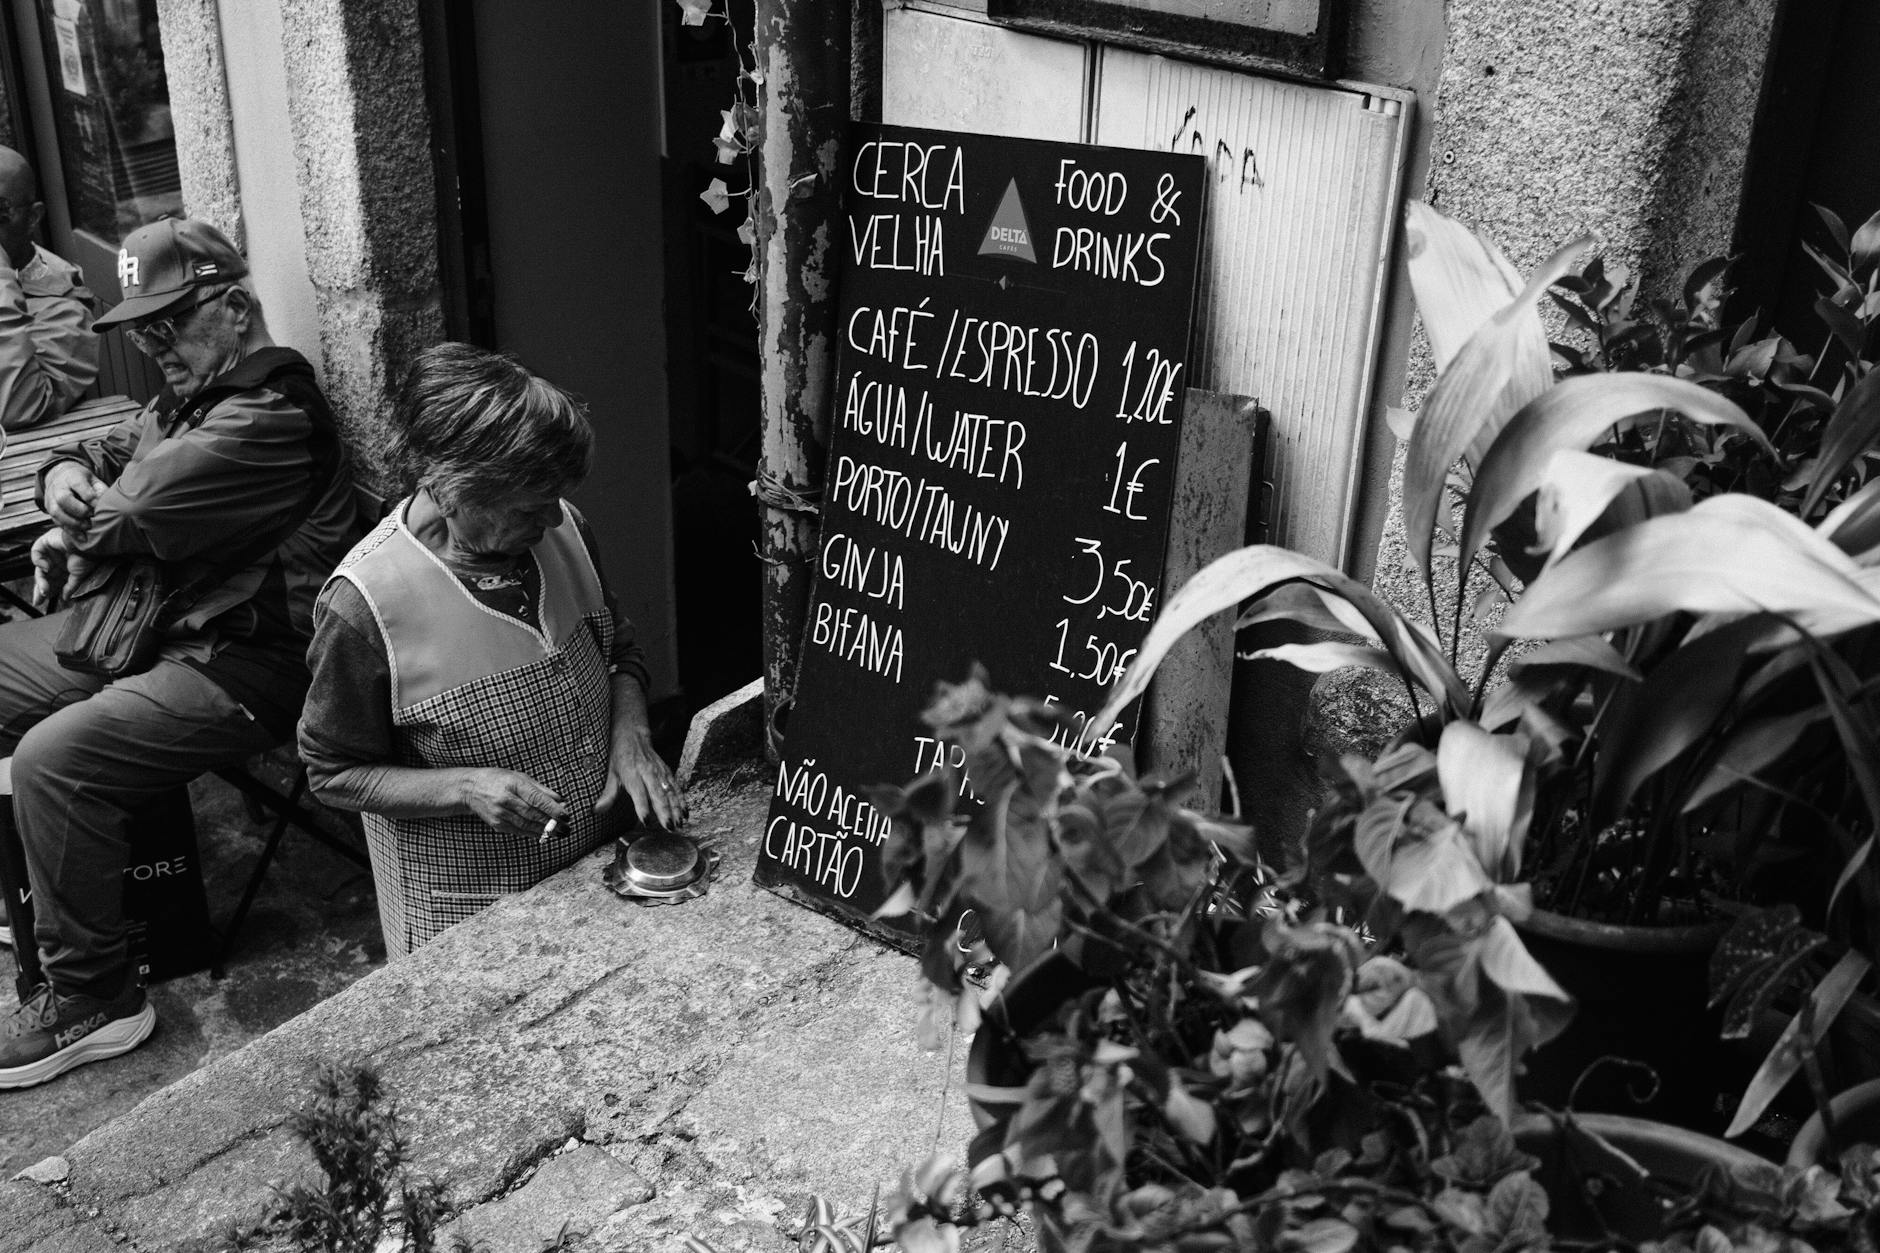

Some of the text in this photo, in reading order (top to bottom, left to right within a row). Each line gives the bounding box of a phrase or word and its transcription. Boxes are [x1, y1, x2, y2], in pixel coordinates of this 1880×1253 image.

[854, 142, 965, 214] CERCA
[1055, 159, 1182, 225] FOOD &
[849, 215, 944, 276] VELHA
[991, 226, 1028, 245] DELTA
[1053, 228, 1170, 286] DRINKS
[849, 297, 935, 369] CAFÉ
[1116, 341, 1182, 424] 1,20€
[1103, 442, 1160, 520] 1€
[823, 534, 904, 610] GINJA
[1063, 537, 1155, 622] 3,50€
[813, 603, 904, 683] BIFANA
[776, 758, 892, 847] NÃO ACEITA
[765, 815, 864, 898] CARTÃO
[54, 1012, 108, 1049] HOKA
